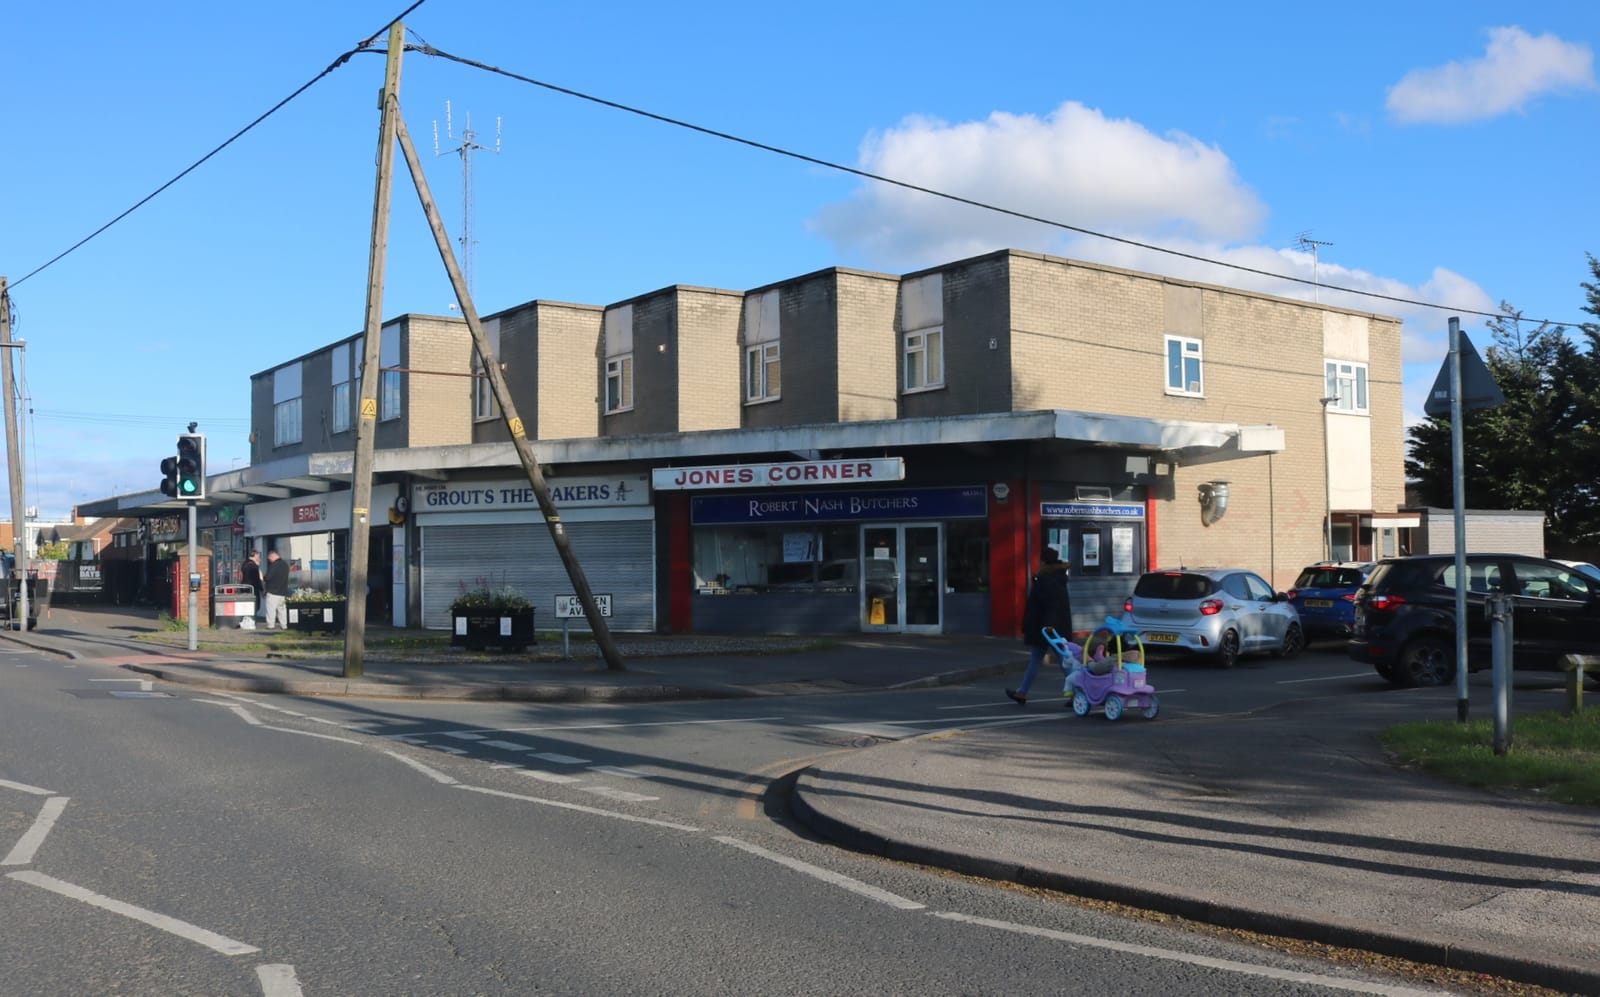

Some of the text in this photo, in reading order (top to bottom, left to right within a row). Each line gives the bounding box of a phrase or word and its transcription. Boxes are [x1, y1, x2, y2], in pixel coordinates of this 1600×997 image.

[674, 463, 873, 486] JONES CORNER
[426, 488, 495, 507] GROUT'S
[499, 488, 535, 504] THE
[547, 484, 610, 502] AKERS
[298, 506, 320, 520] SPAR
[79, 570, 101, 578] DAYS
